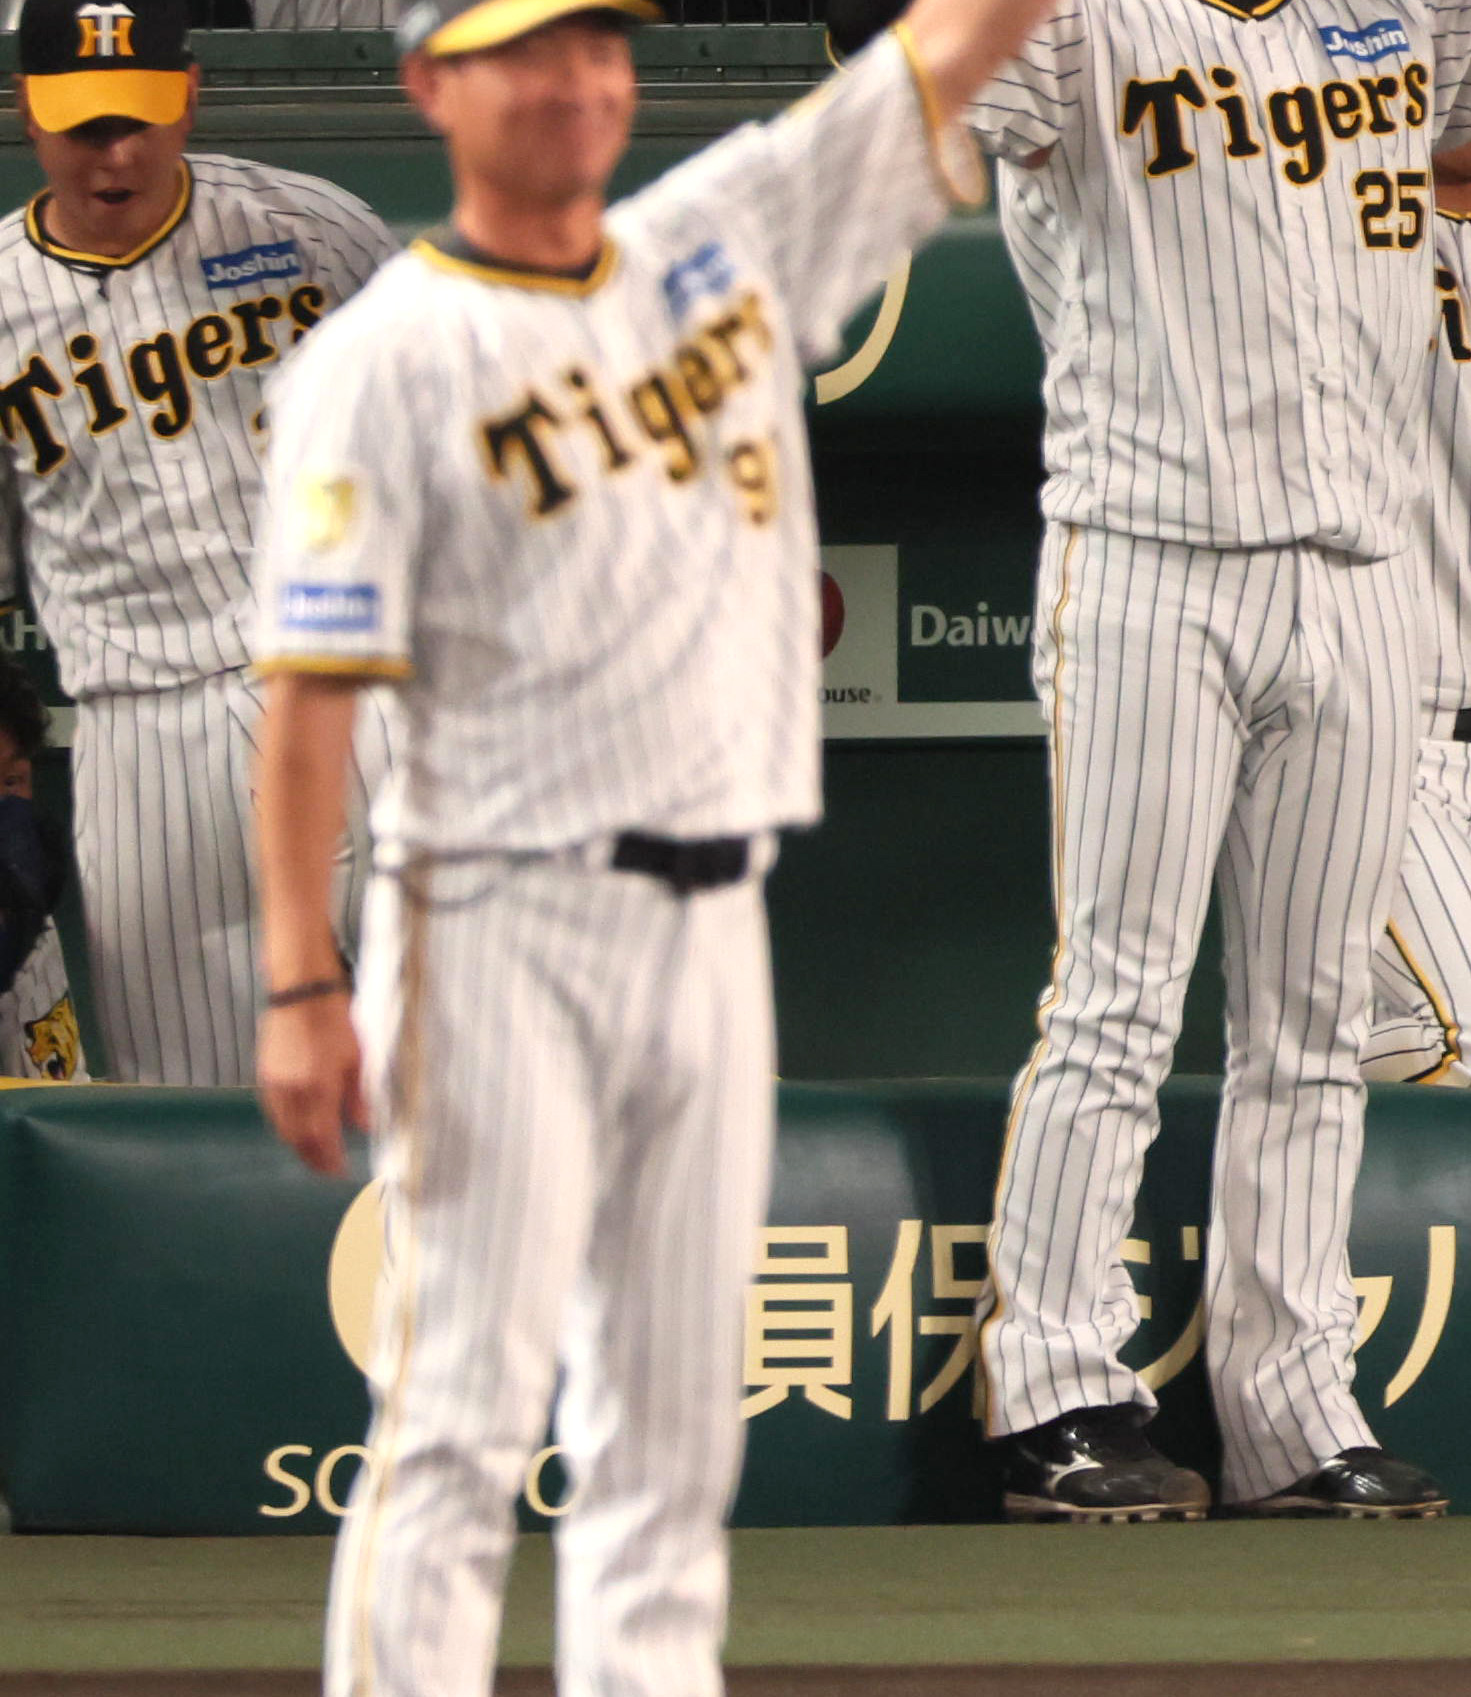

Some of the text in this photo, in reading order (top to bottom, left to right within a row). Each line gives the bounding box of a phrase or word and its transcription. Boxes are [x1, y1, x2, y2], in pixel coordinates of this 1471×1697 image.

[1121, 62, 1430, 185] Tigers
[206, 250, 300, 287] Joshin
[1353, 171, 1431, 252] 25
[0, 283, 325, 476] Tigers
[475, 290, 776, 522] Tigers
